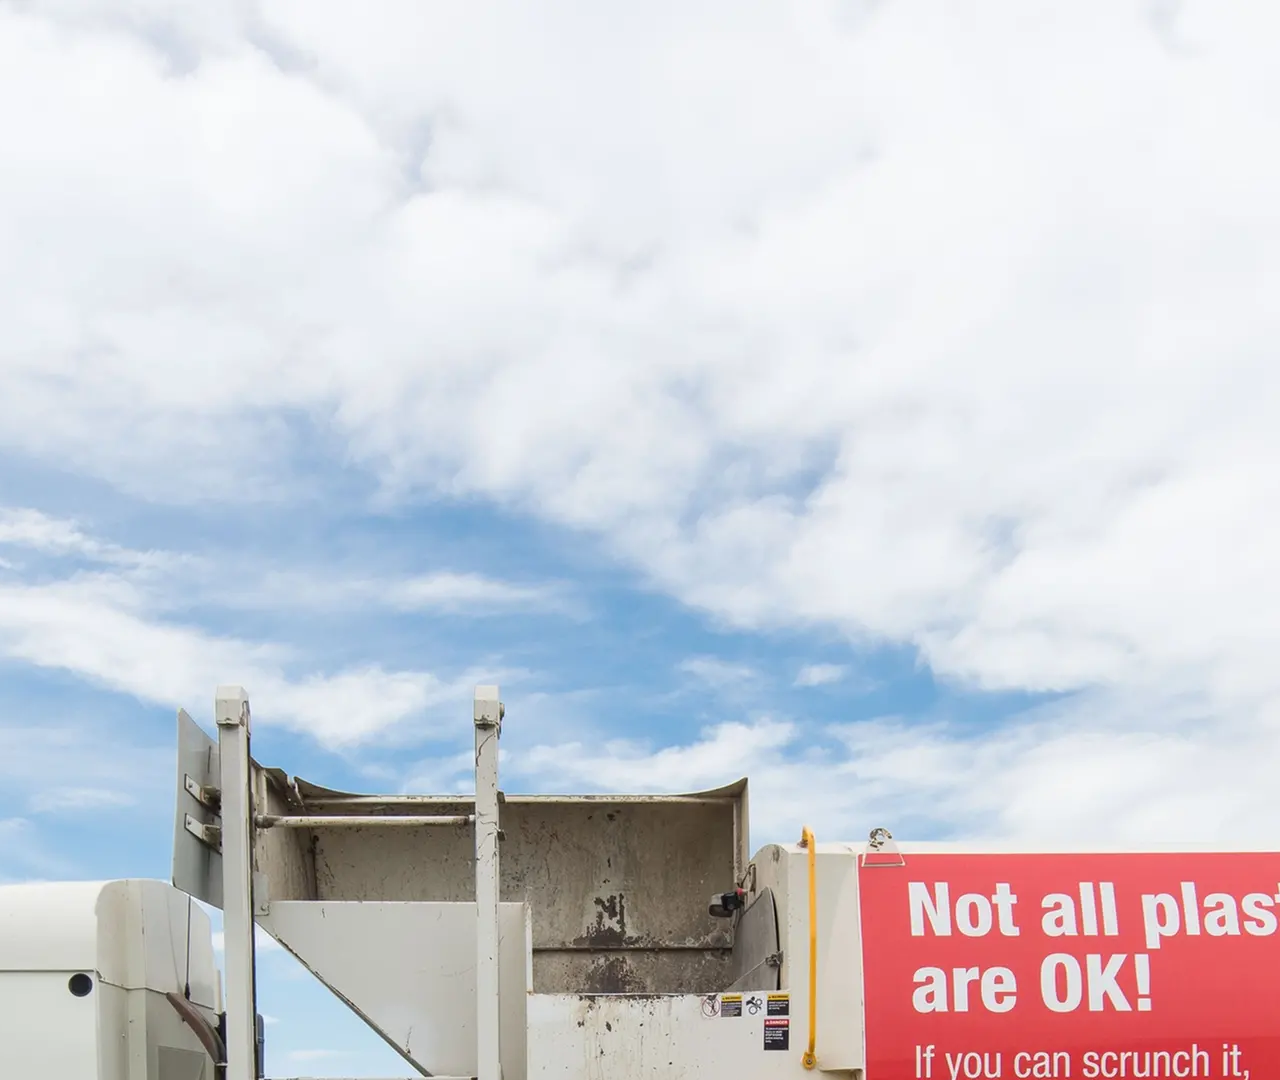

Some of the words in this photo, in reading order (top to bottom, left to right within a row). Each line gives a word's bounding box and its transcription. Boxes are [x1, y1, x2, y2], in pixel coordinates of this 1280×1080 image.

[908, 881, 1020, 937] Not
[1041, 881, 1119, 937] all
[912, 966, 1017, 1014] are
[1040, 952, 1152, 1013] OK!
[915, 1044, 935, 1079] If
[1014, 1051, 1070, 1079] can
[1082, 1043, 1209, 1079] scrunch
